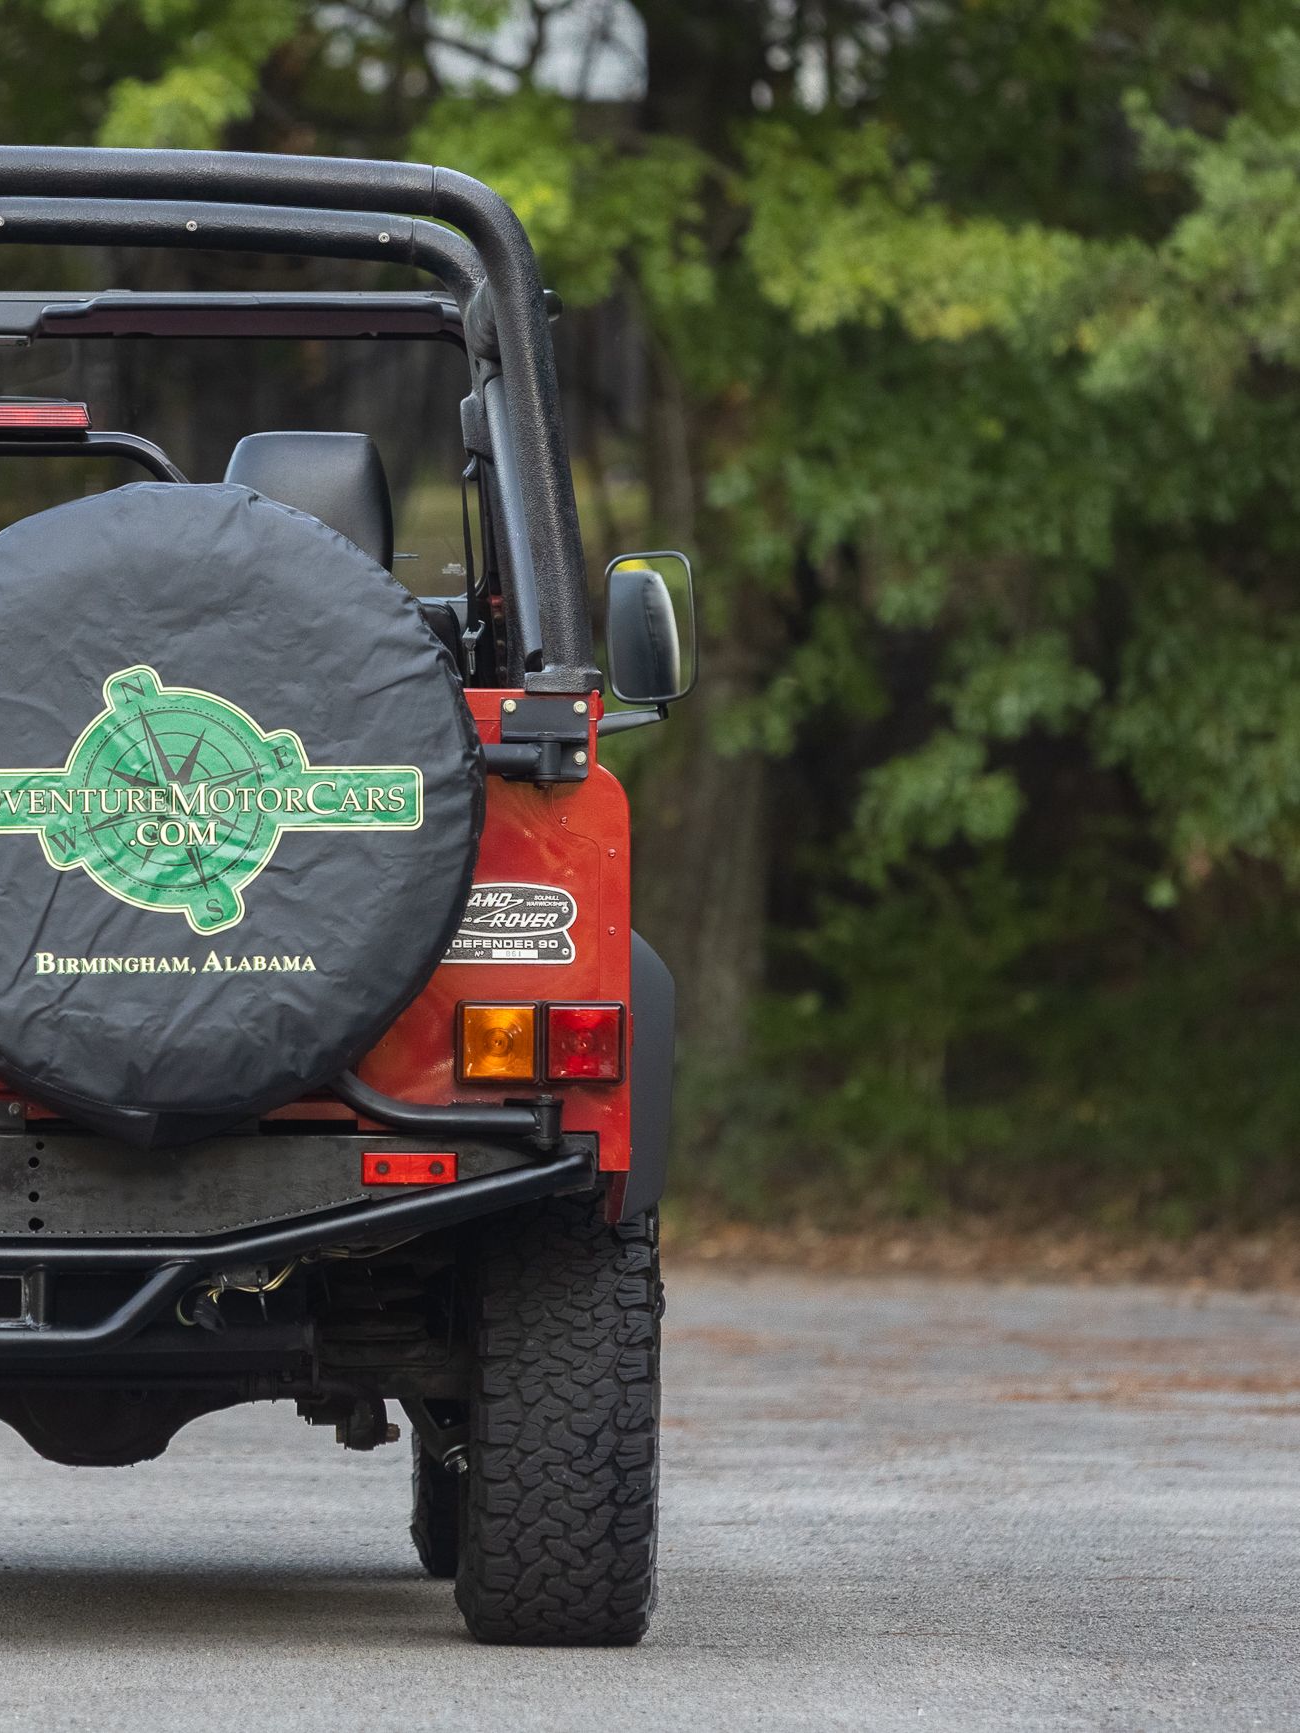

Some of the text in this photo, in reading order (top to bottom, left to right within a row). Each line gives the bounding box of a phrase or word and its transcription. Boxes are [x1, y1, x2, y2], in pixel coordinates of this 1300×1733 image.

[120, 675, 147, 704] N
[270, 744, 294, 770] E
[49, 826, 77, 854] W
[128, 821, 218, 847] .COM
[206, 899, 224, 922] S
[467, 893, 513, 907] AND
[490, 913, 559, 927] ROVER
[452, 939, 559, 948] DEFENDER 90
[35, 949, 317, 975] BIRMINGHAM, ALABAMA
